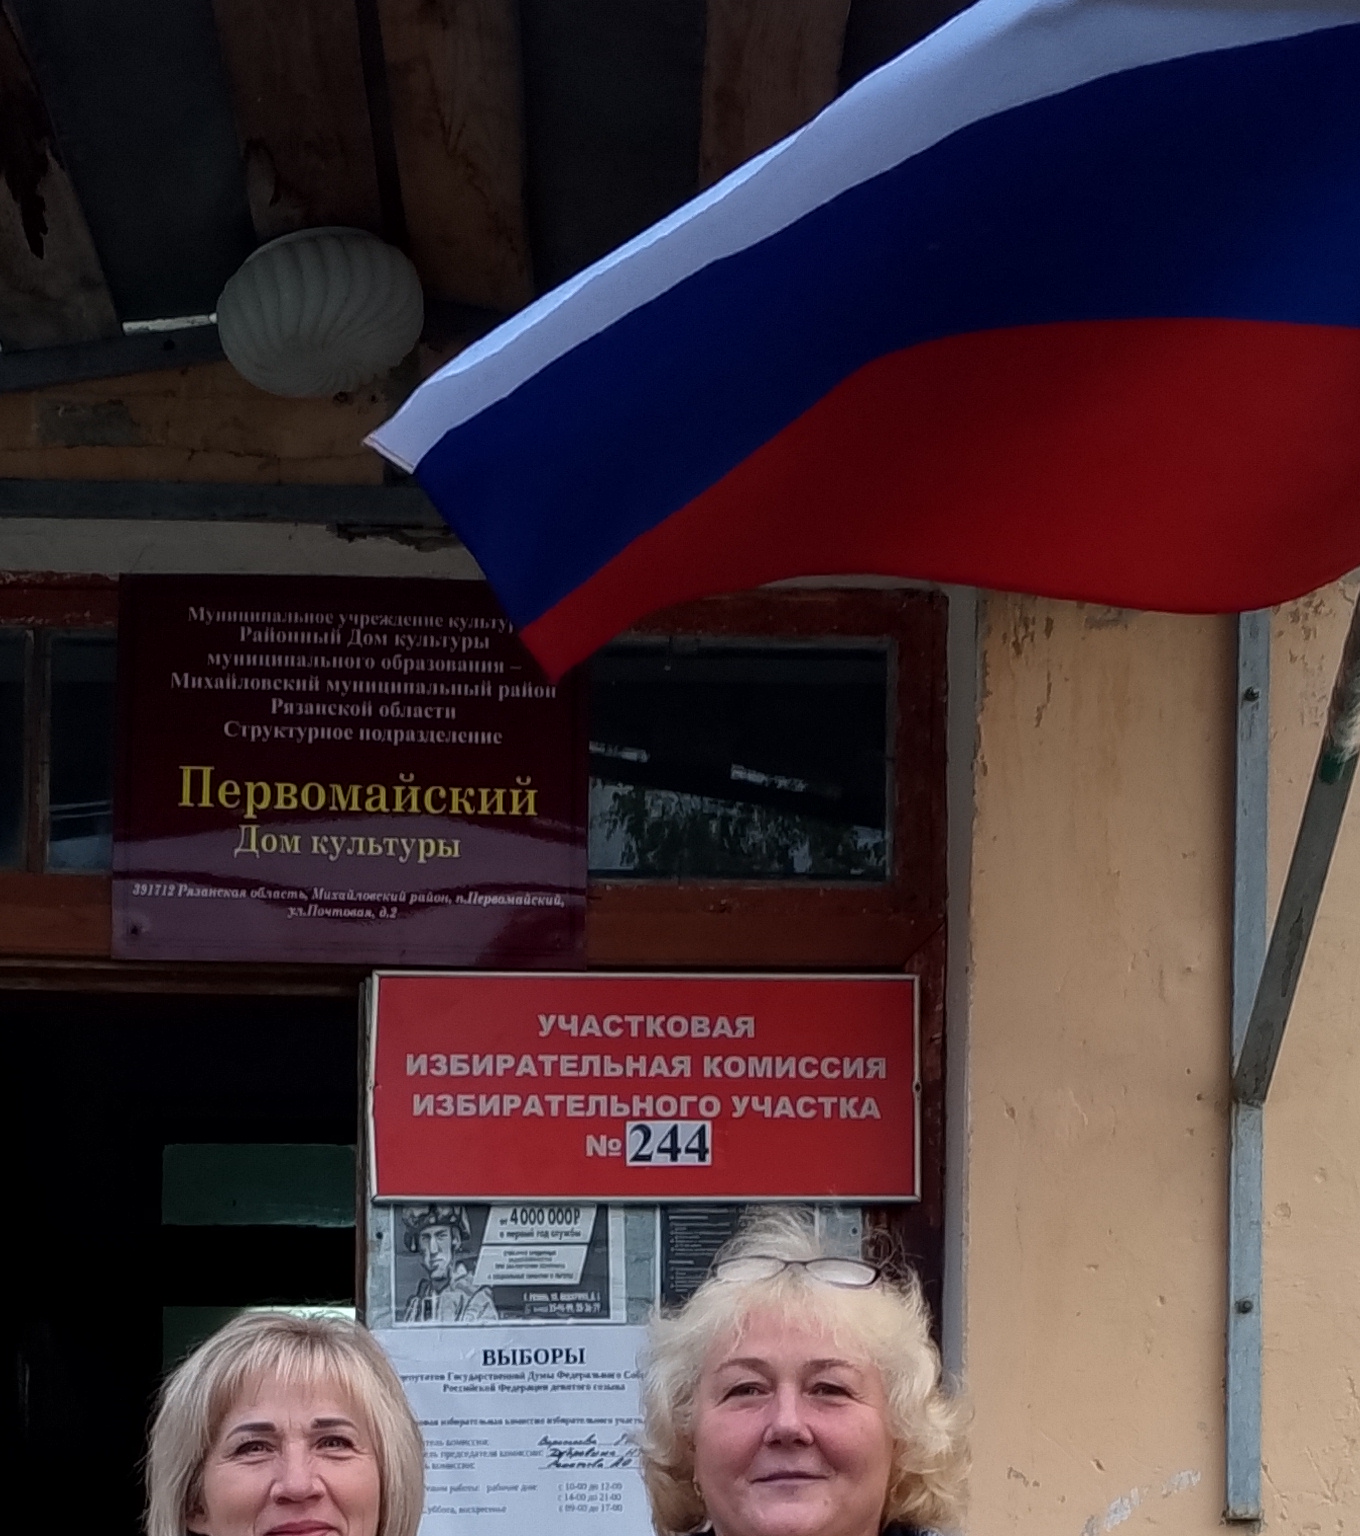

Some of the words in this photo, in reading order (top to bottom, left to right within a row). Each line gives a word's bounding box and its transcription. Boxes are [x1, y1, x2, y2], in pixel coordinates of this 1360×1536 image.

[188, 606, 334, 626] Муниципальное
[338, 612, 444, 630] учреждение
[240, 625, 342, 646] Районный
[346, 628, 388, 648] Дом
[394, 633, 490, 654] культуры
[207, 653, 376, 671] муниципального
[381, 653, 505, 675] образования
[171, 672, 320, 692] Михайловский
[326, 678, 492, 698] муниципальный
[498, 680, 557, 702] район
[271, 697, 373, 718] Рязанской
[378, 700, 456, 720] области
[223, 720, 354, 744] Структурное
[359, 727, 503, 747] подразделение
[178, 765, 539, 818] Первомайский
[234, 824, 302, 859] Дом
[311, 834, 462, 864] культуры
[177, 884, 247, 899] Рязанская
[311, 886, 407, 902] Михайловский
[537, 1014, 756, 1039] УЧАСТКОВАЯ
[406, 1053, 692, 1079] ИЗБИРАТЕЛЬНАЯ
[703, 1055, 888, 1080] КОМИССИЯ
[412, 1093, 722, 1118] ИЗБИРАТЕЛЬНОГО
[732, 1095, 881, 1120] УЧАСТКА
[586, 1134, 622, 1157] №
[628, 1121, 711, 1165] 244
[482, 1347, 587, 1367] ВЫБОРЫ
[400, 1374, 446, 1384] епутатов
